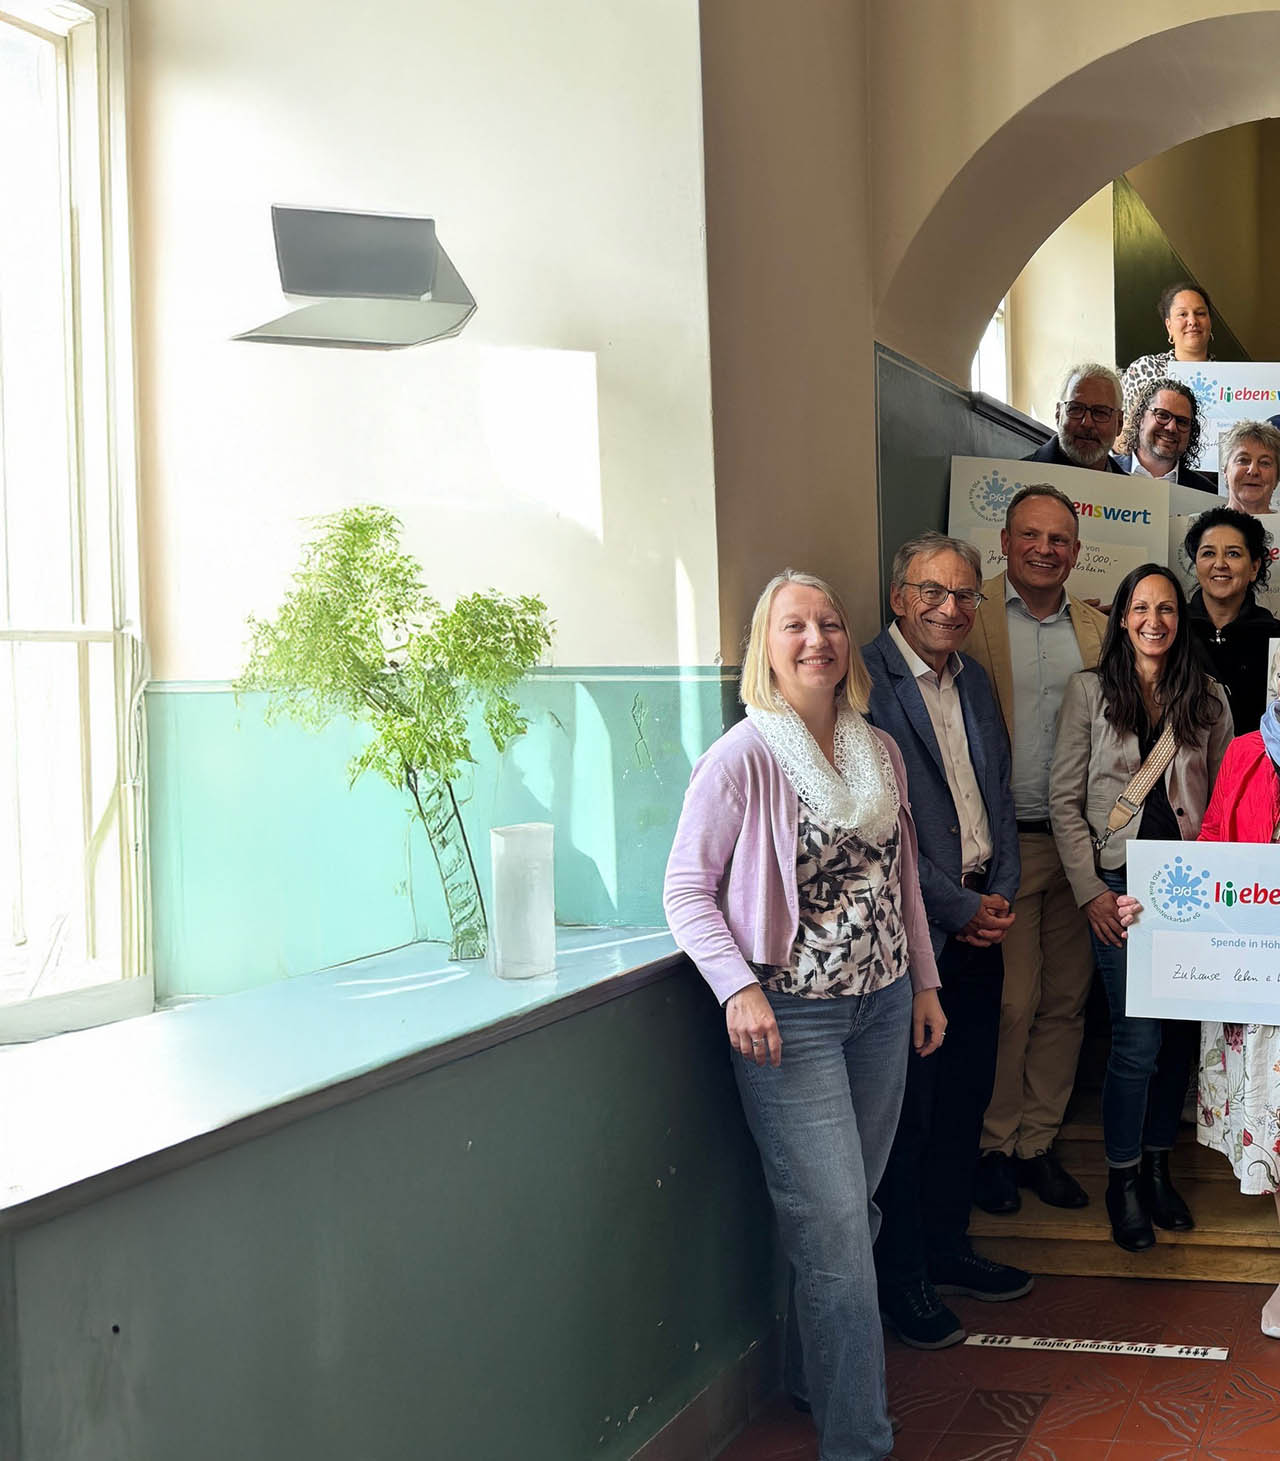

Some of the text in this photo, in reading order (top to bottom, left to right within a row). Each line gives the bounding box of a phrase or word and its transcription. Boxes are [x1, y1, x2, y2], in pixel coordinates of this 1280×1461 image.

[1085, 544, 1101, 553] von
[1211, 938, 1247, 949] Spende
[1249, 938, 1258, 948] in
[1033, 1340, 1156, 1354] Bitte Abstand halten
